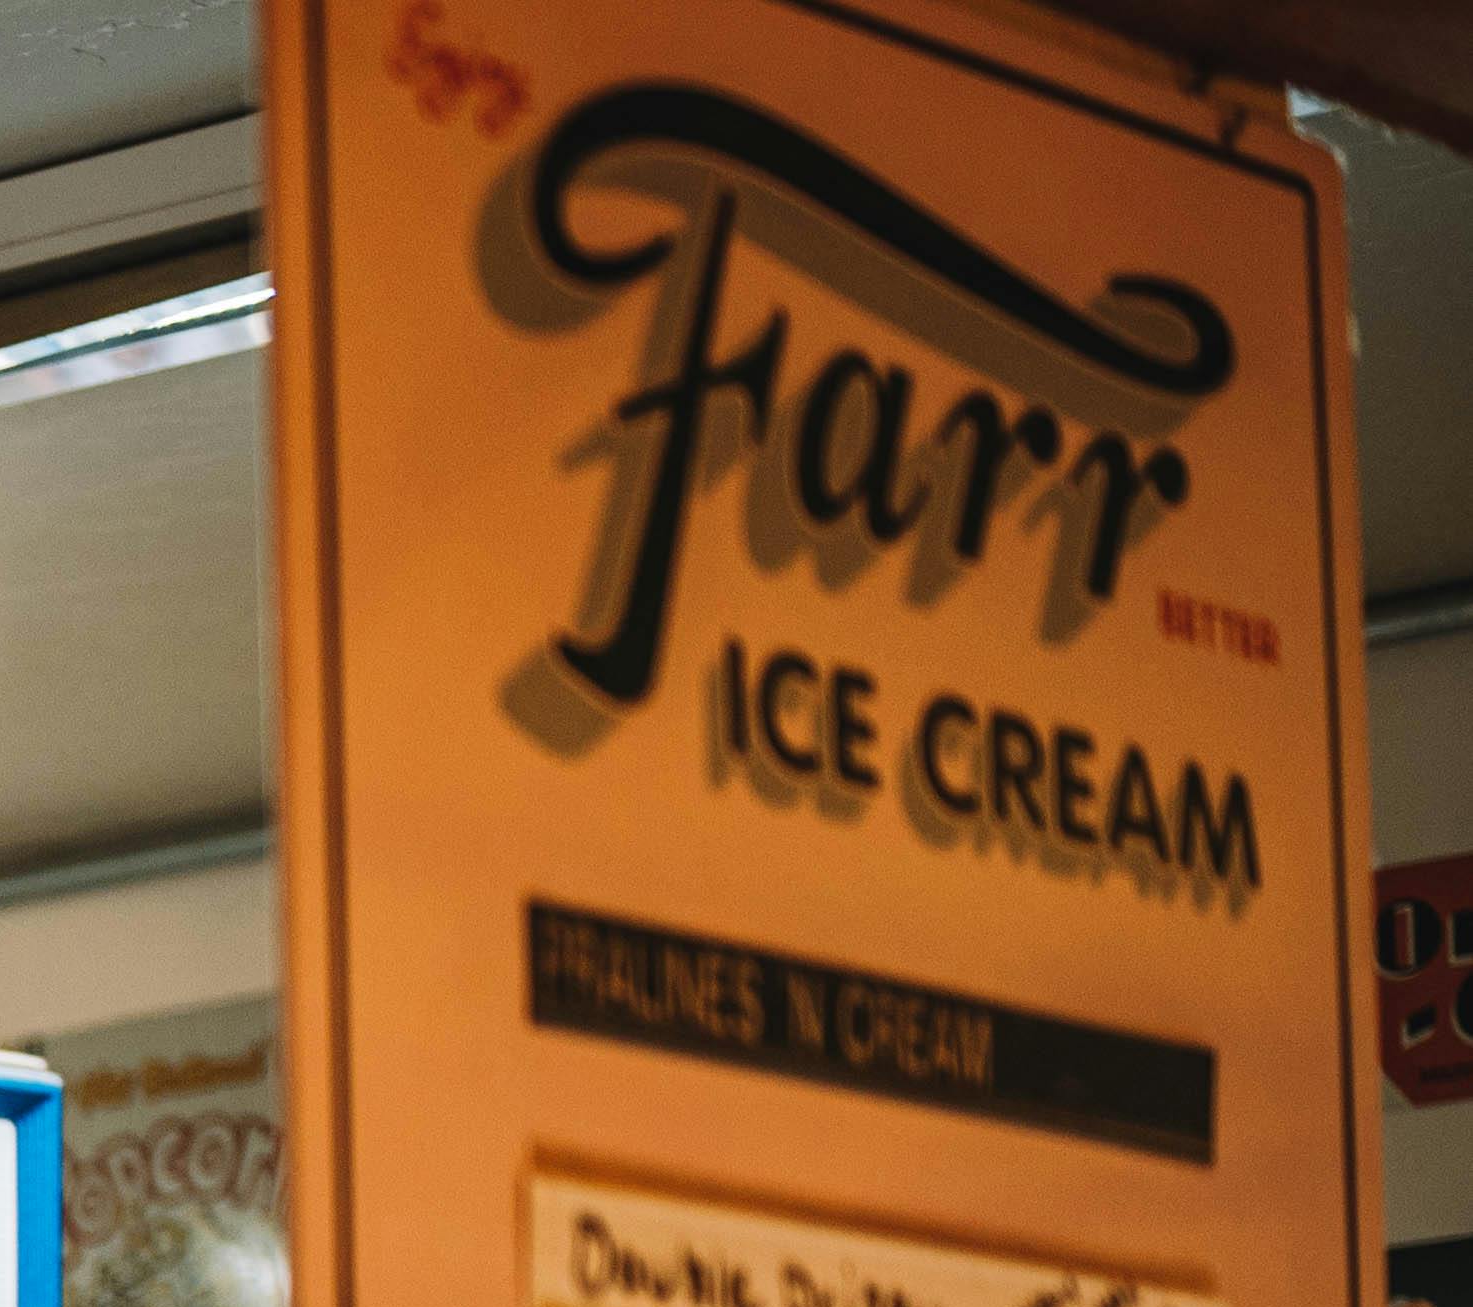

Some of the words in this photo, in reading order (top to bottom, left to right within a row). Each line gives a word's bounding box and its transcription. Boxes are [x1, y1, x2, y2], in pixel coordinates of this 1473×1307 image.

[536, 76, 1236, 705] Farr
[727, 636, 881, 792] ICE
[920, 691, 1261, 890] CREAM
[835, 995, 995, 1087] CREAM
